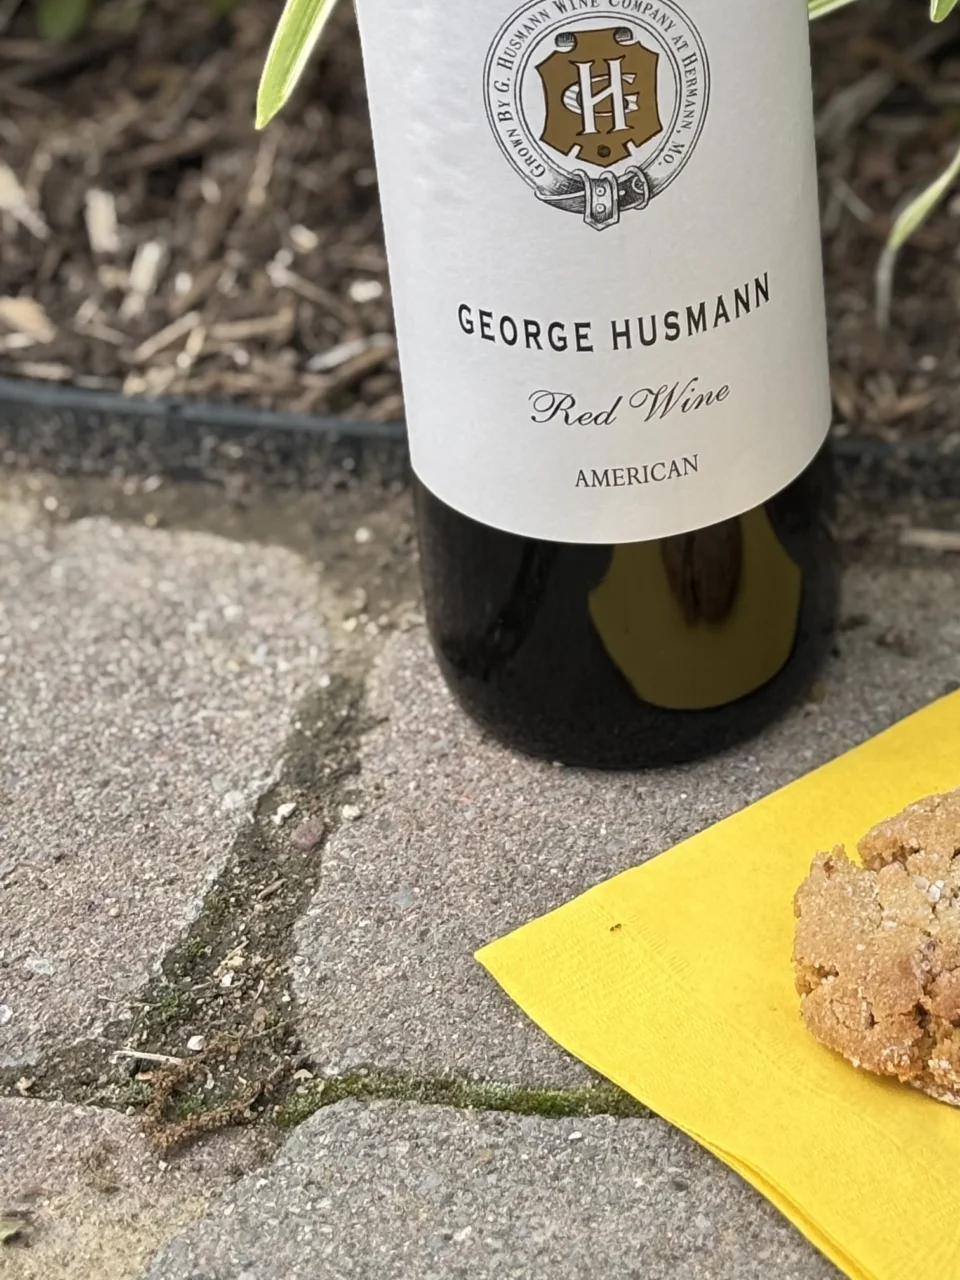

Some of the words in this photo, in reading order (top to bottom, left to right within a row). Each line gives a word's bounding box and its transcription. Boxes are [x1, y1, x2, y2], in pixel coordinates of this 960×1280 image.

[458, 303, 594, 352] GEORGE
[611, 272, 770, 350] HUSMANN
[528, 389, 623, 426] Red
[628, 376, 731, 422] Wine
[574, 453, 699, 488] AMERICAN
